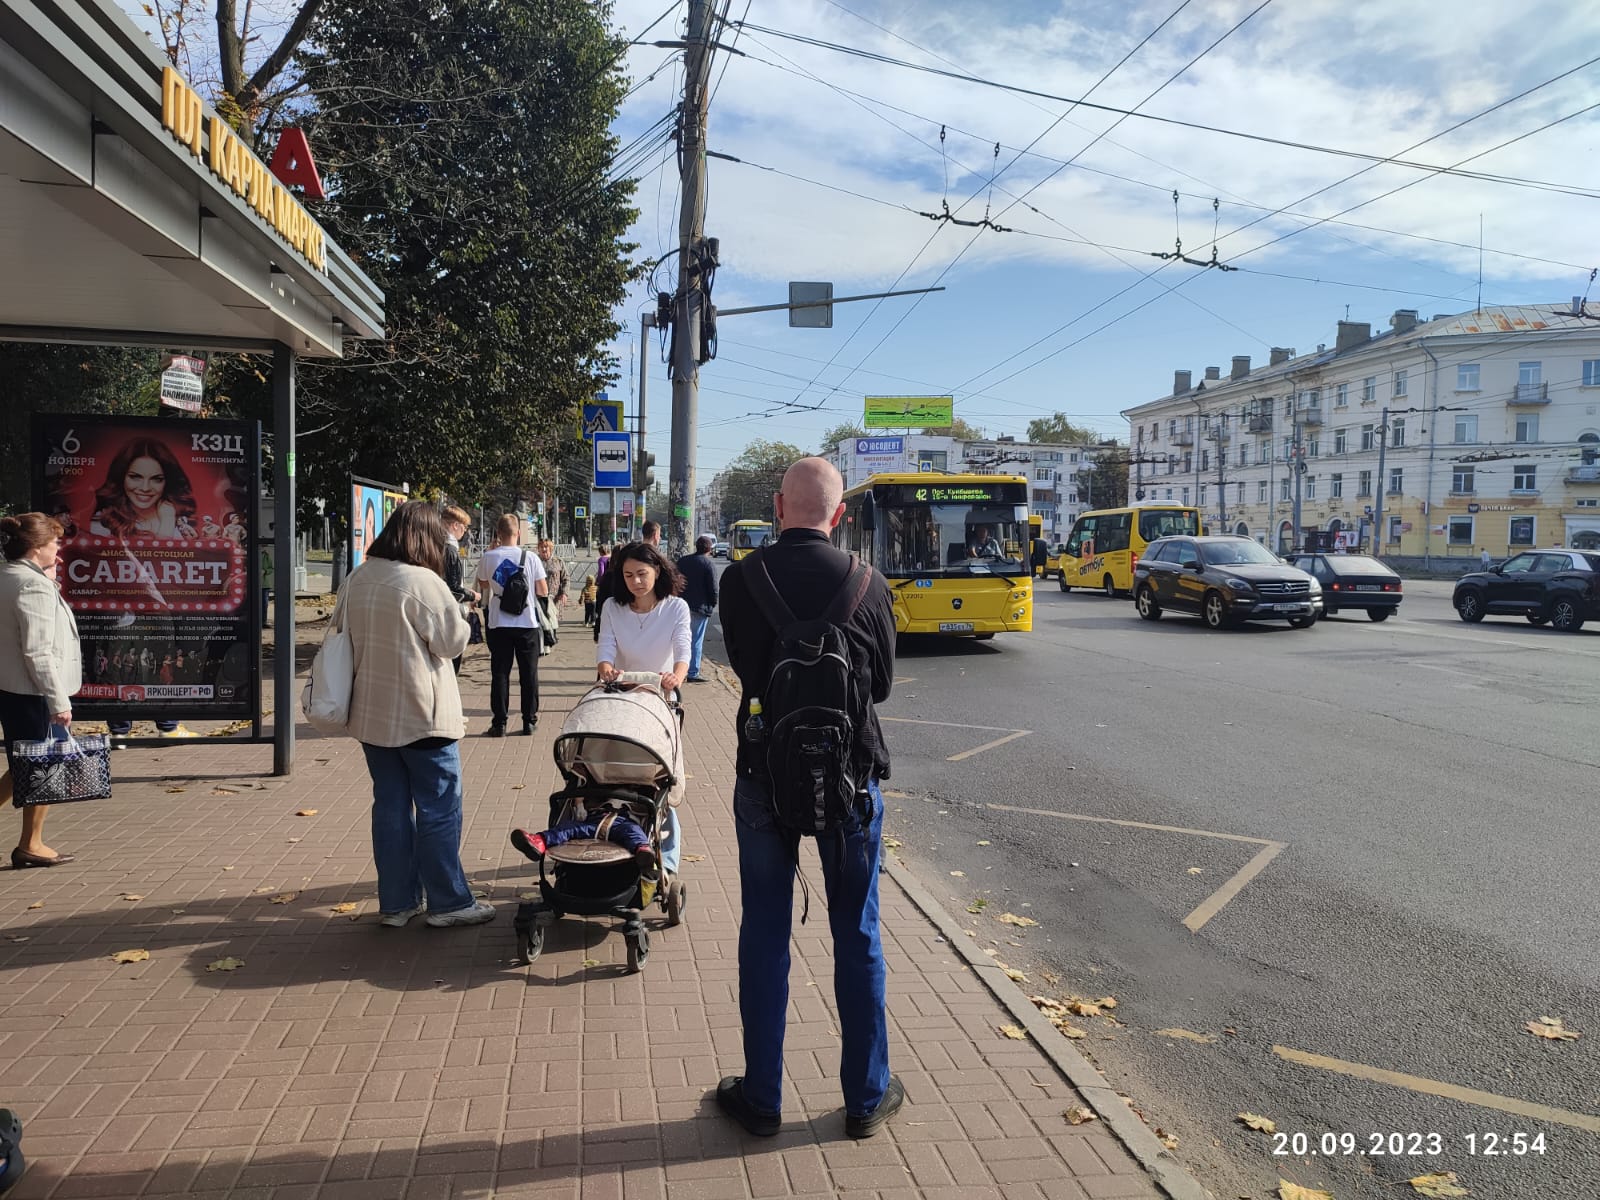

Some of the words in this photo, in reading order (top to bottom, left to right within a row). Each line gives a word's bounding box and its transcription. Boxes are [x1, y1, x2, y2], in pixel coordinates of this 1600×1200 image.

[269, 127, 326, 199] А
[209, 116, 275, 226] КАРЛА
[274, 184, 329, 277] МАРКСА
[62, 428, 81, 454] 6
[191, 433, 244, 456] КЗЦ
[48, 456, 96, 466] НОЯБРЯ
[915, 488, 928, 501] 42
[153, 550, 195, 559] СТОЦКАЯ
[68, 559, 227, 585] CABARET
[81, 686, 116, 697] БИЛЕТЫ
